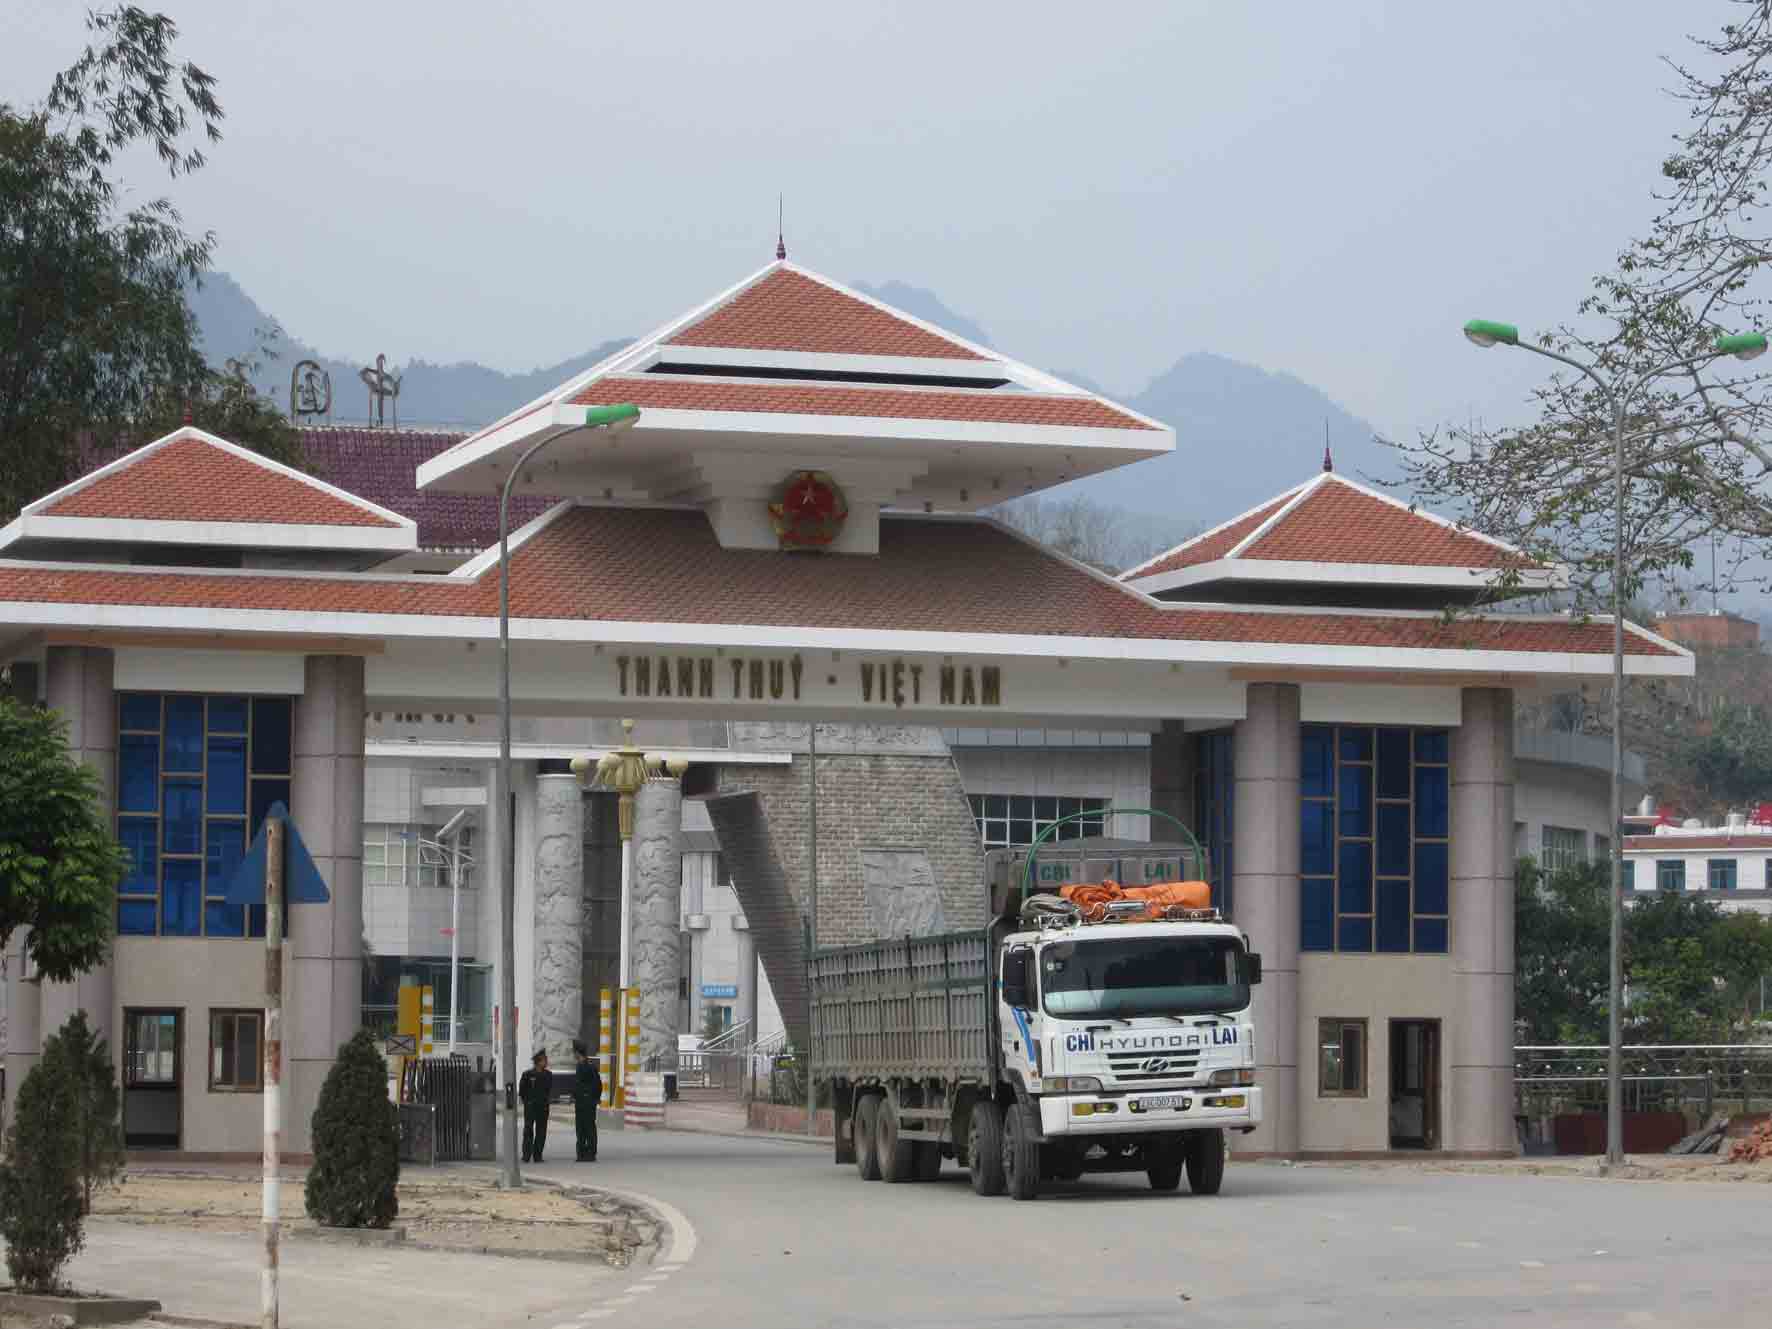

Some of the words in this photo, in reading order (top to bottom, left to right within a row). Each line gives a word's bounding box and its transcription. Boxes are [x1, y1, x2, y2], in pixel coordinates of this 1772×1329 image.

[616, 655, 713, 697] THANH
[940, 665, 1001, 705] NAM
[1100, 1034, 1209, 1050] HYUNDAI
[1212, 1026, 1238, 1046] LAI
